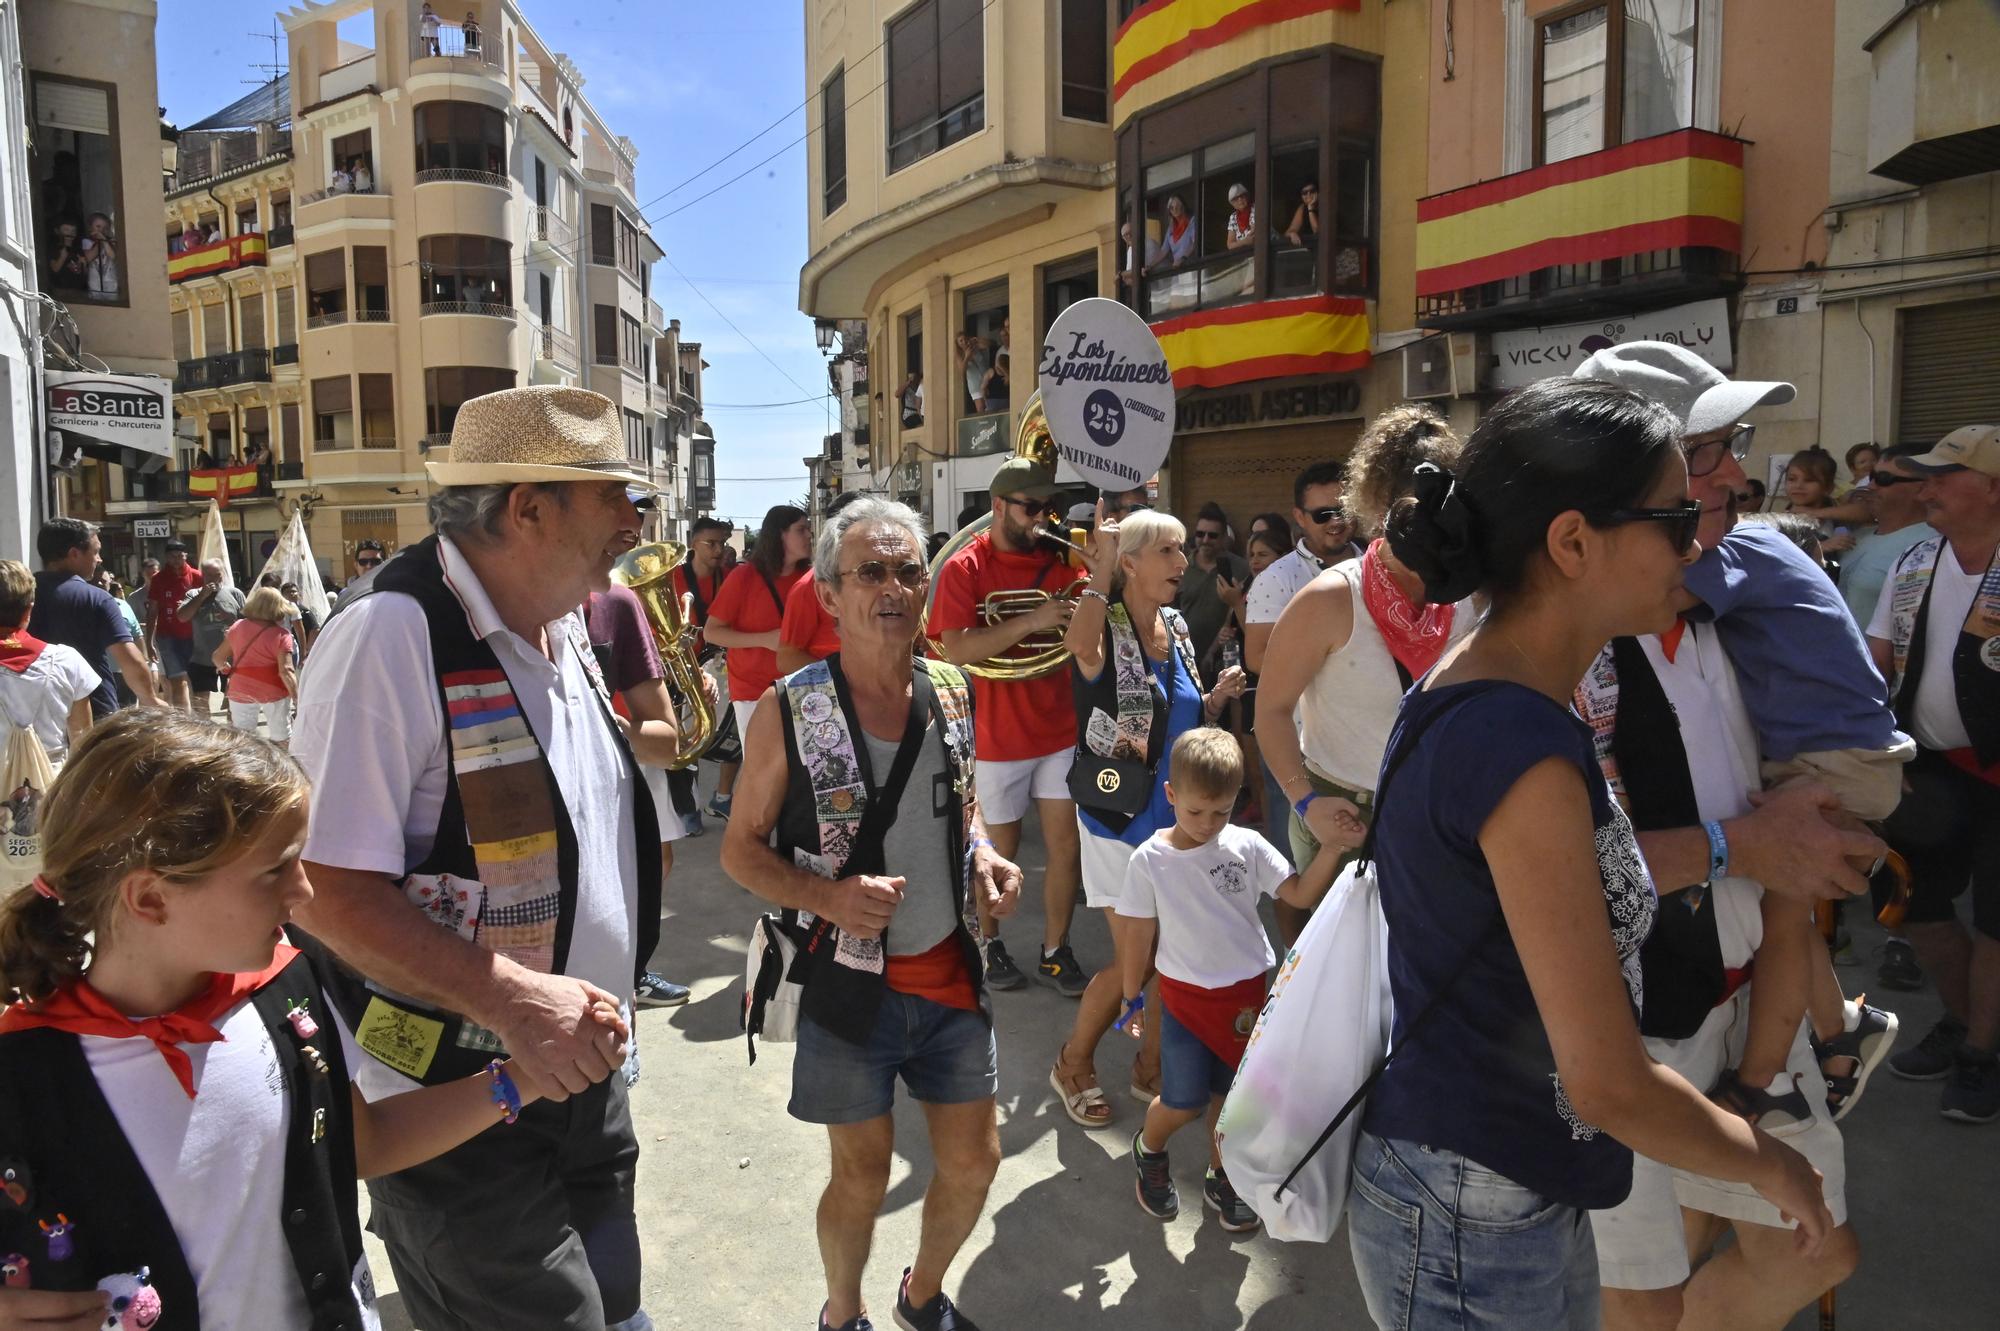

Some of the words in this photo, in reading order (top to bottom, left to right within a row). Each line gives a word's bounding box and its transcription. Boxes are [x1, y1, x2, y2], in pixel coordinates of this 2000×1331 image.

[1781, 300, 1794, 312] 29
[1067, 331, 1108, 360] Los
[1039, 345, 1172, 386] Espontáneos
[48, 390, 163, 417] LaSanta
[1260, 379, 1361, 421] ASENSIO
[1088, 402, 1120, 435] 25
[137, 527, 168, 537] BLAY
[1592, 703, 1619, 715] SEGO
[9, 838, 37, 846] SEGO
[9, 846, 37, 856] 202
